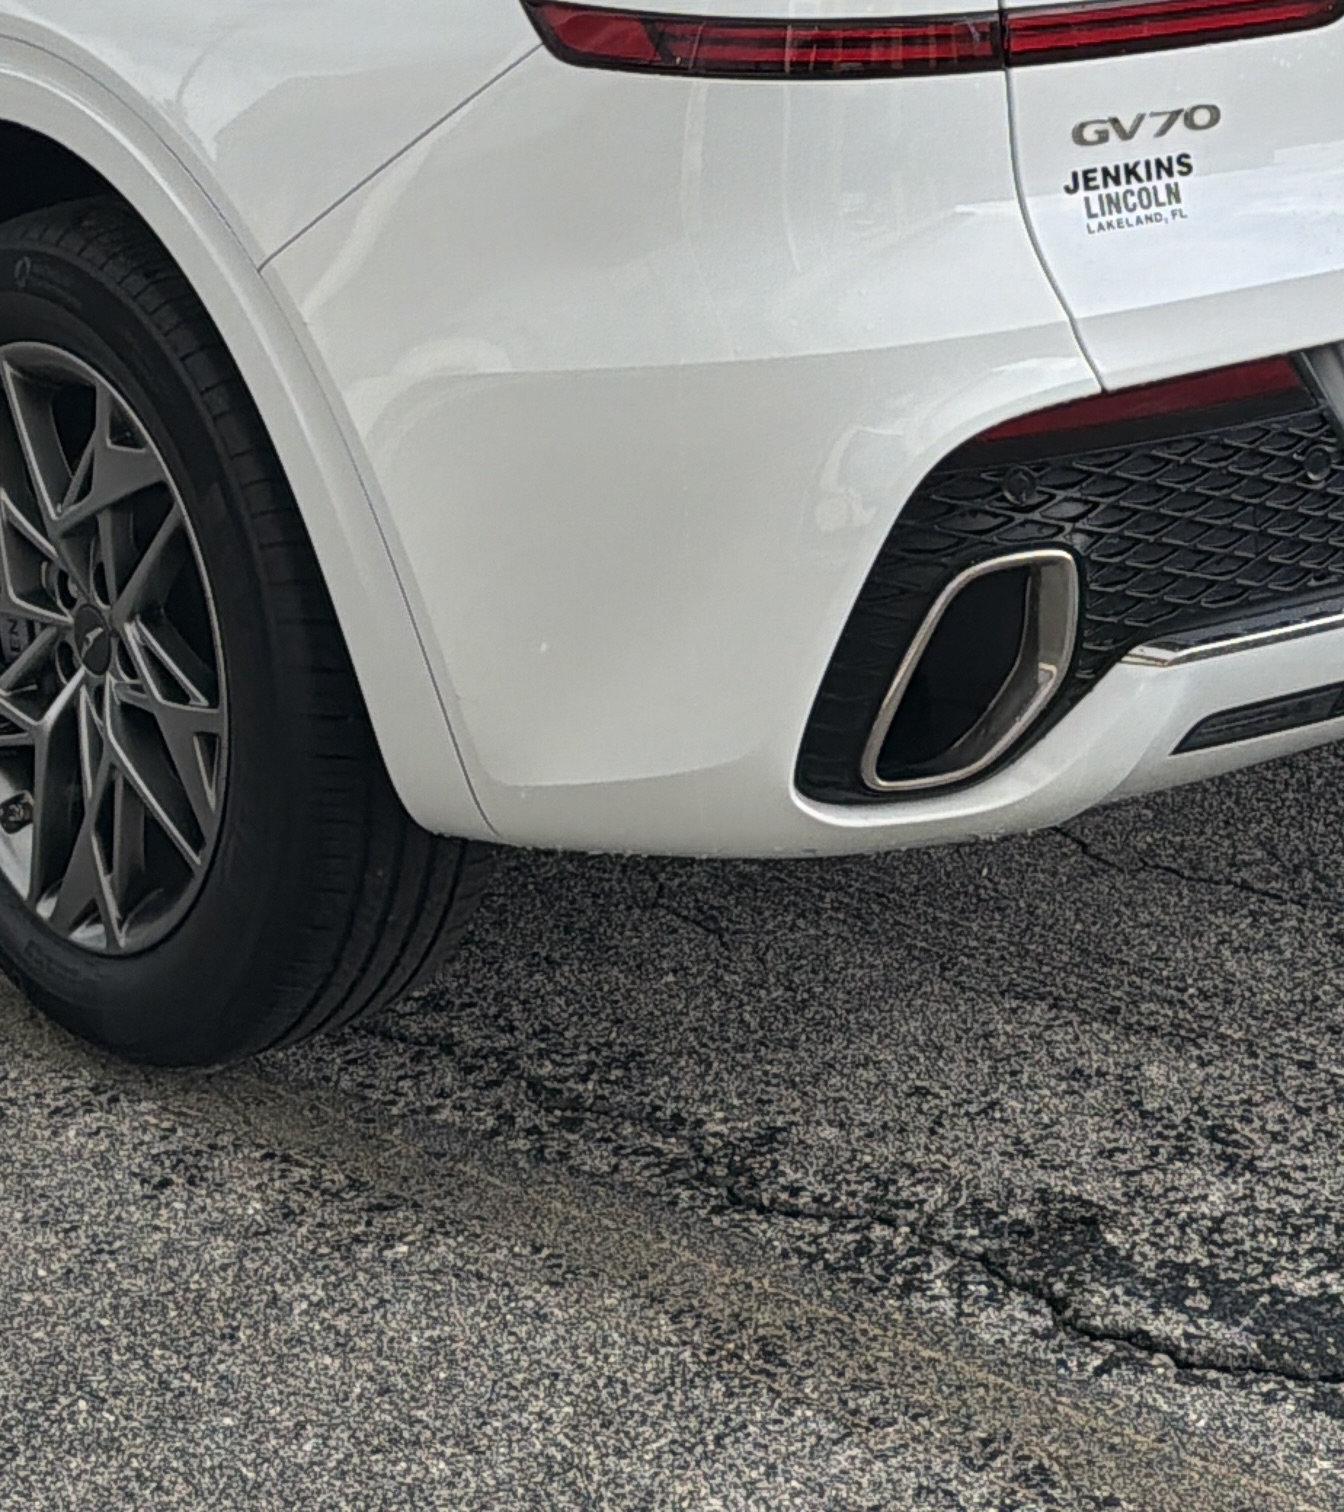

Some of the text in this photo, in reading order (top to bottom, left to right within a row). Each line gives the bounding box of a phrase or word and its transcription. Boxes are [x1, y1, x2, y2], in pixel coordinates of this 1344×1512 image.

[1071, 104, 1221, 146] GV70
[1063, 152, 1194, 195] JENKINS
[1083, 182, 1182, 219] LINCOLN
[1170, 207, 1188, 221] FL
